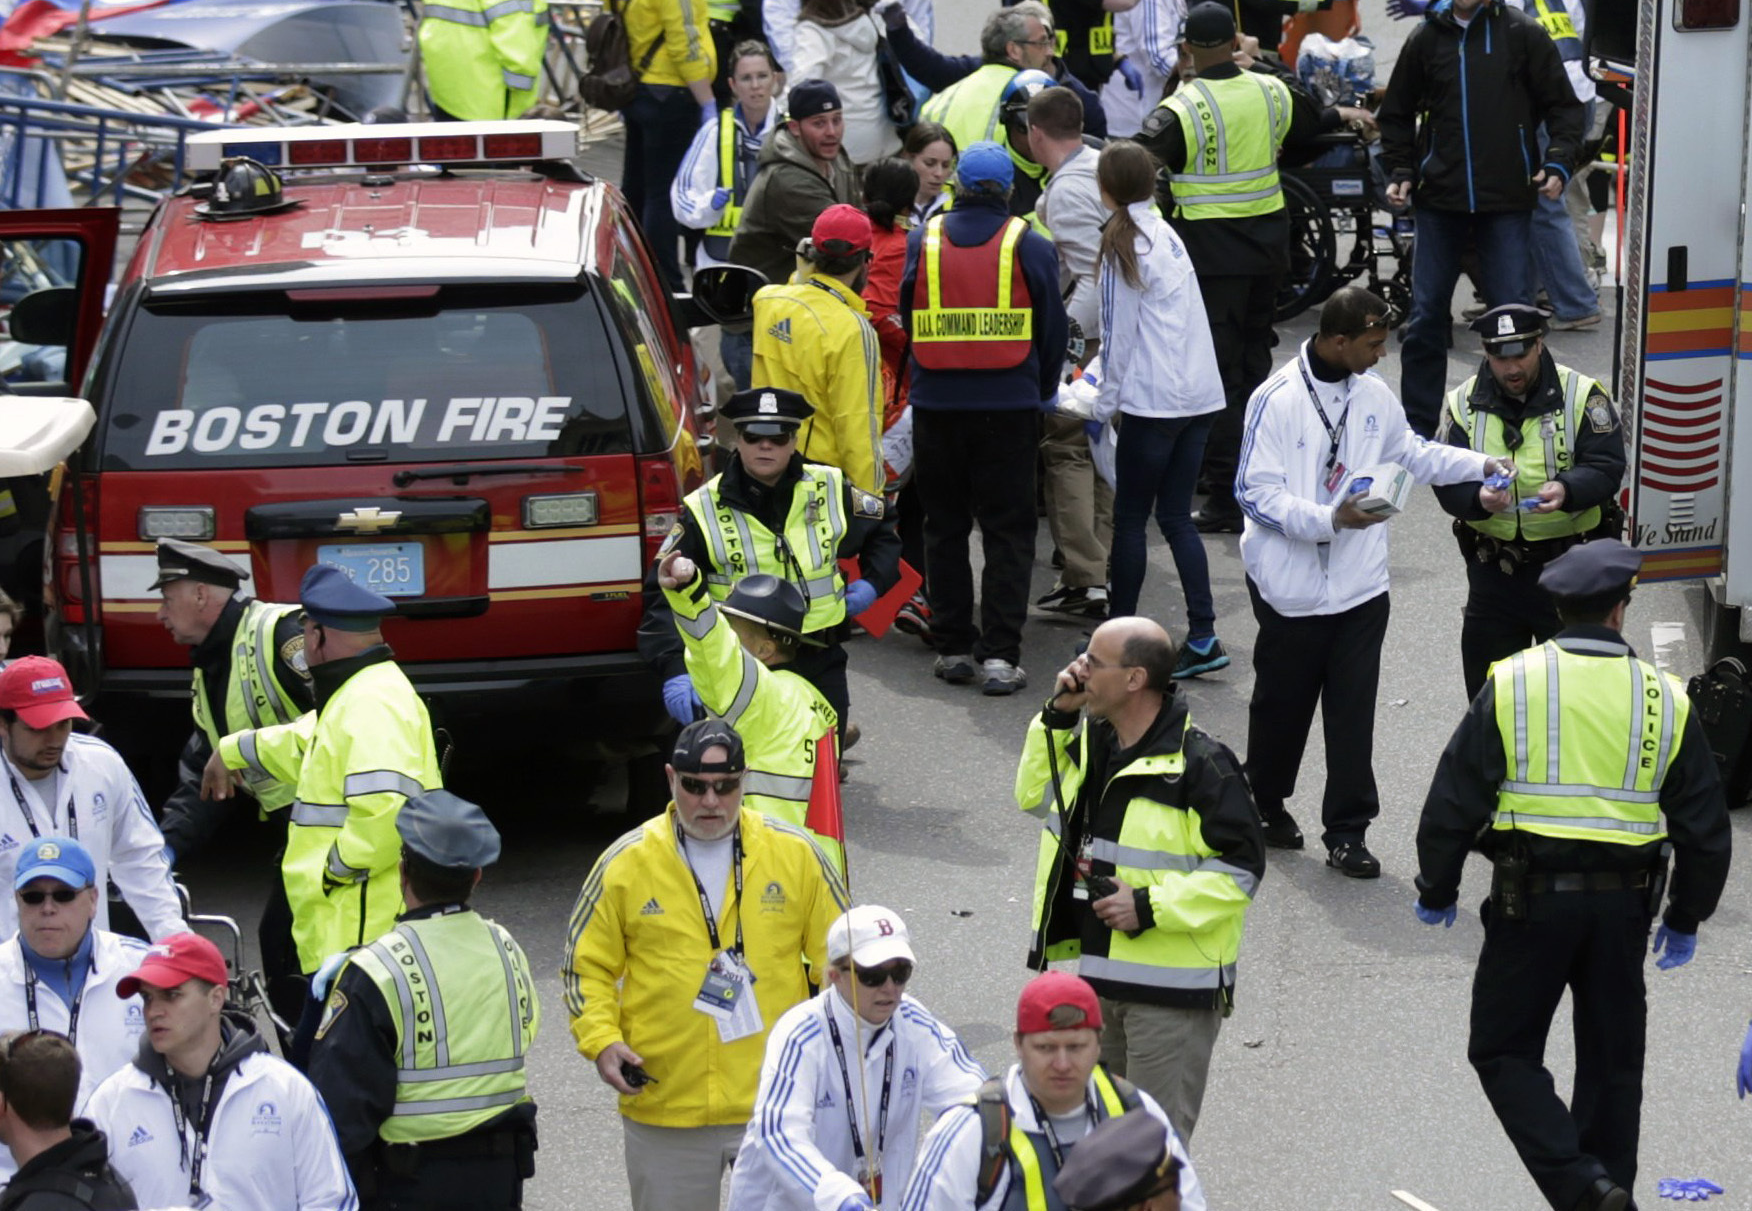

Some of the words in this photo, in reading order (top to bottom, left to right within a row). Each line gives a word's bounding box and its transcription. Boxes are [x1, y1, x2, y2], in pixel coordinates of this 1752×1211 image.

[1196, 101, 1217, 167] BOSTON
[936, 313, 977, 337] COMMAND
[980, 312, 1026, 336] LEADERSHIP
[145, 398, 426, 456] BOSTON
[436, 396, 572, 443] FIRE
[715, 501, 745, 574] BOSTON
[1661, 517, 1718, 545] Stand
[366, 557, 412, 584] 285
[248, 630, 268, 708] POLIC
[1641, 672, 1660, 769] POLICE
[873, 918, 894, 937] B
[393, 942, 433, 1043] BOSTON
[505, 940, 530, 1030] OLICE
